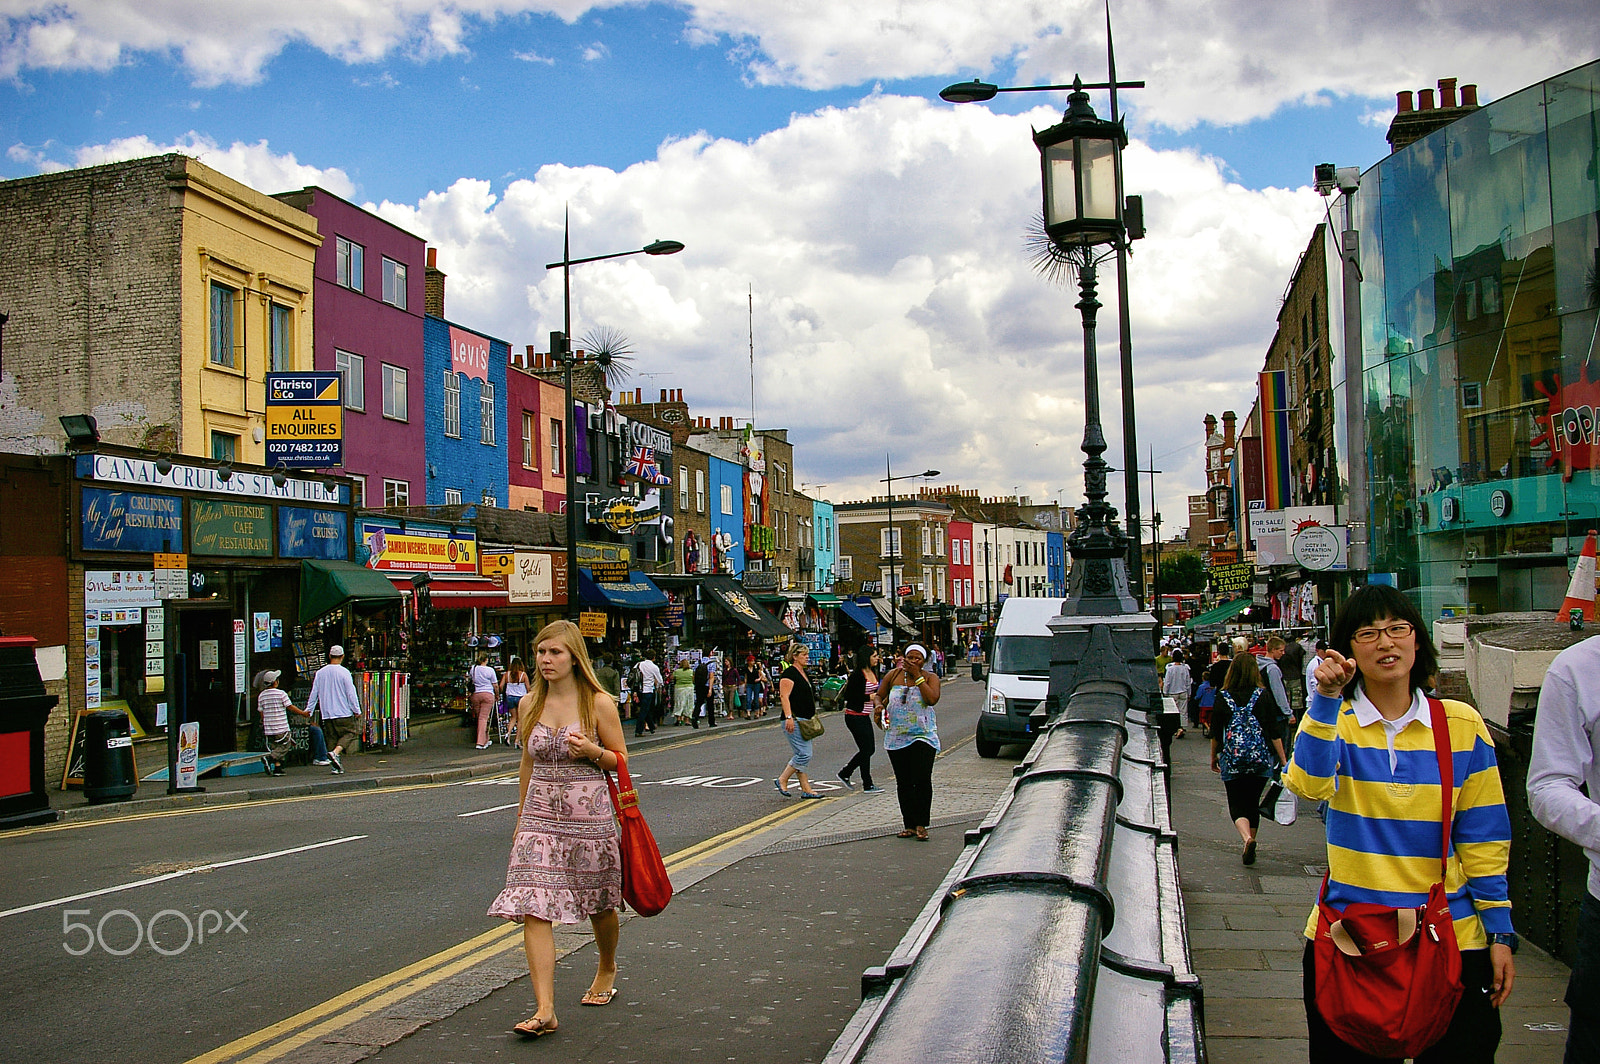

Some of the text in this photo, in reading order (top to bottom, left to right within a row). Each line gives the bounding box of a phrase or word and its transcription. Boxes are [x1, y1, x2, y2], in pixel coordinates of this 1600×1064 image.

[453, 339, 487, 370] Levi's
[273, 380, 313, 390] Christo
[292, 409, 316, 421] ALL
[271, 423, 337, 436] ENQUIRIES
[269, 444, 339, 453] 020 7482 1203
[95, 456, 338, 502] CANAL CRUISES START HERE
[130, 495, 174, 512] CRUISING
[86, 497, 101, 533] My
[222, 504, 265, 520] WATERSIDE
[313, 512, 335, 525] CANAL
[125, 513, 182, 530] RESTAURANT
[94, 519, 124, 548] Lady
[312, 526, 339, 539] CRUISES
[219, 537, 269, 550] RESTAURANT
[388, 540, 406, 554] CAMBIO
[407, 541, 428, 555] WECHSEL
[428, 544, 446, 556] CHANGE
[390, 561, 406, 569] Shoes
[409, 561, 428, 569] Fashion
[428, 562, 456, 570] Accessories
[591, 562, 628, 570] BUREAU
[191, 572, 205, 587] 250
[1213, 568, 1250, 579] PIERCING
[1218, 582, 1249, 592] STUDIO
[147, 624, 154, 632] 12
[147, 643, 152, 654] 2
[147, 661, 152, 671] 4
